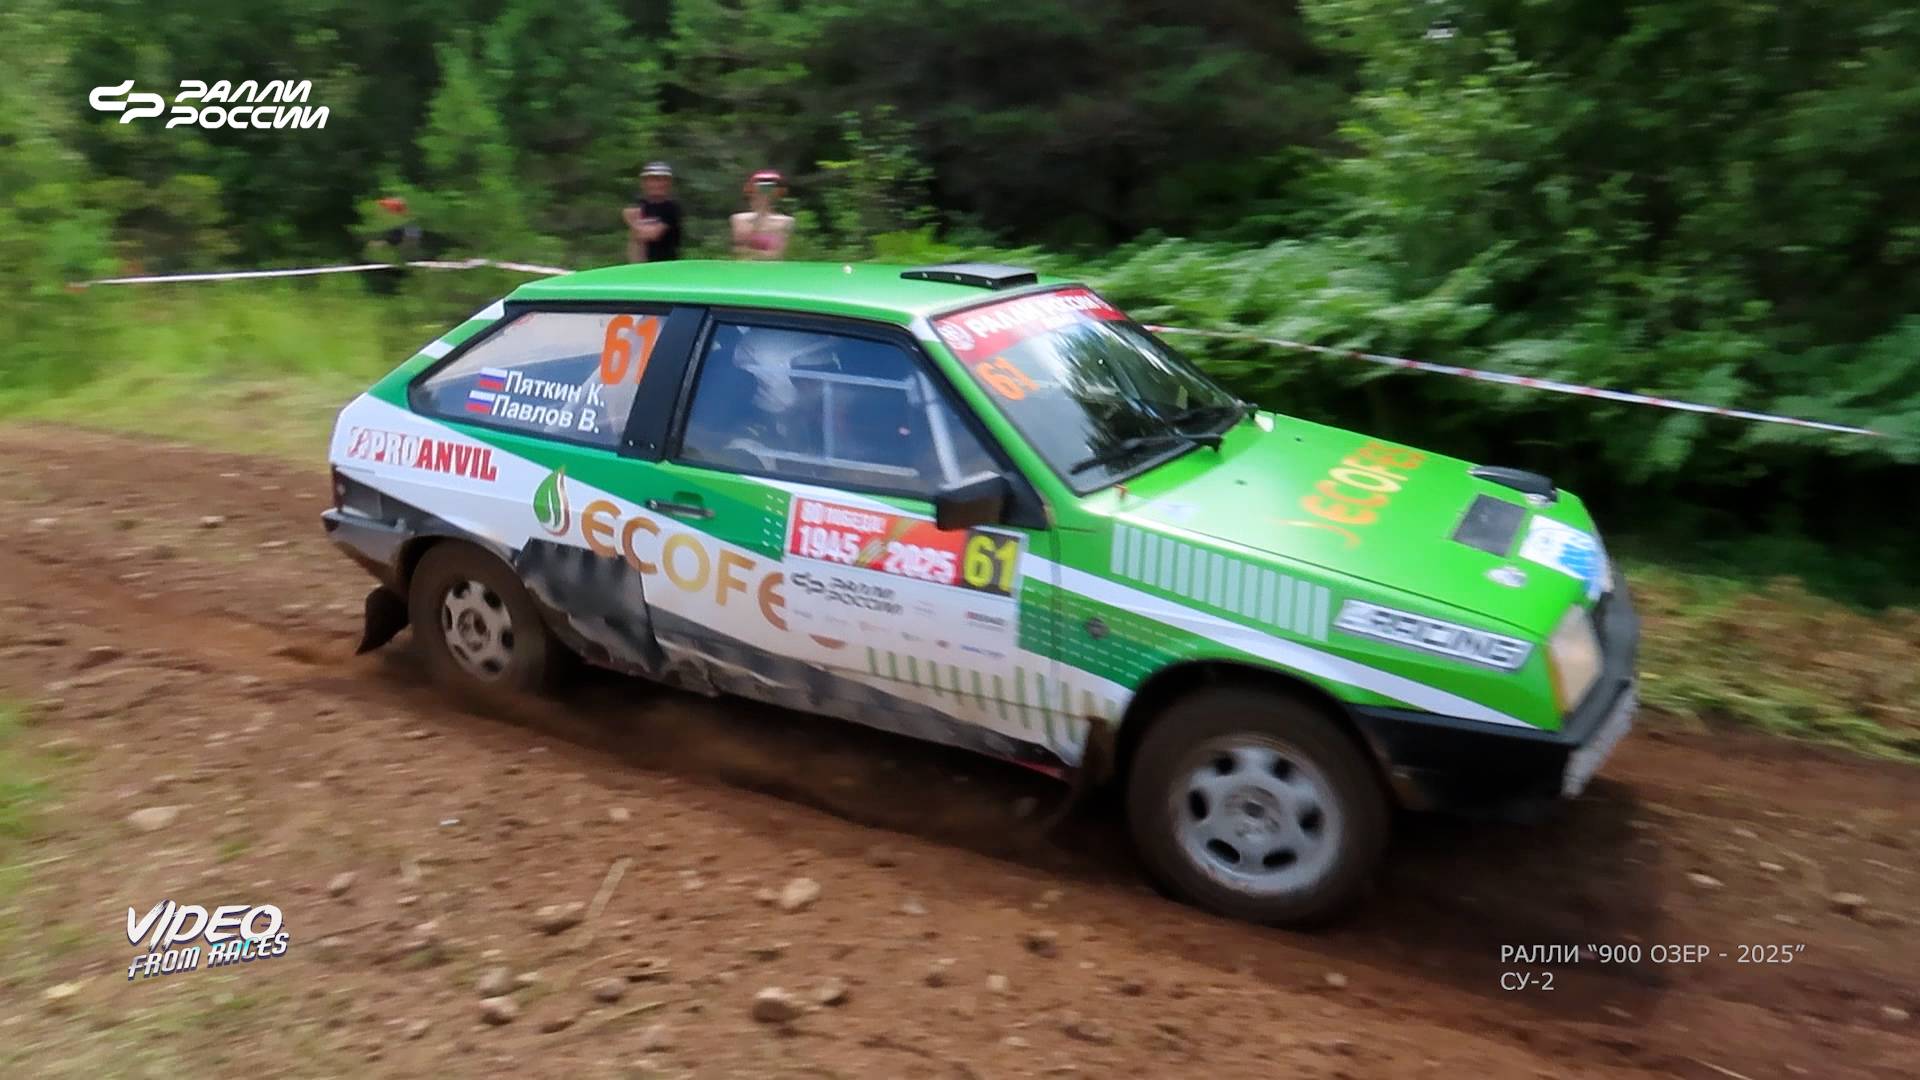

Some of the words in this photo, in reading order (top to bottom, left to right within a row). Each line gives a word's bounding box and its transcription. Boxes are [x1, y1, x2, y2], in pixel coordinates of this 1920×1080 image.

[600, 314, 660, 386] 61
[504, 370, 582, 404] Пяткин
[587, 383, 605, 408] К.
[975, 356, 1041, 401] 61
[491, 394, 574, 429] Павлов
[577, 407, 600, 434] В.
[369, 429, 498, 482] PROANVIL
[798, 524, 861, 565] 1945
[883, 540, 957, 584] 2025
[963, 534, 1020, 592] 61
